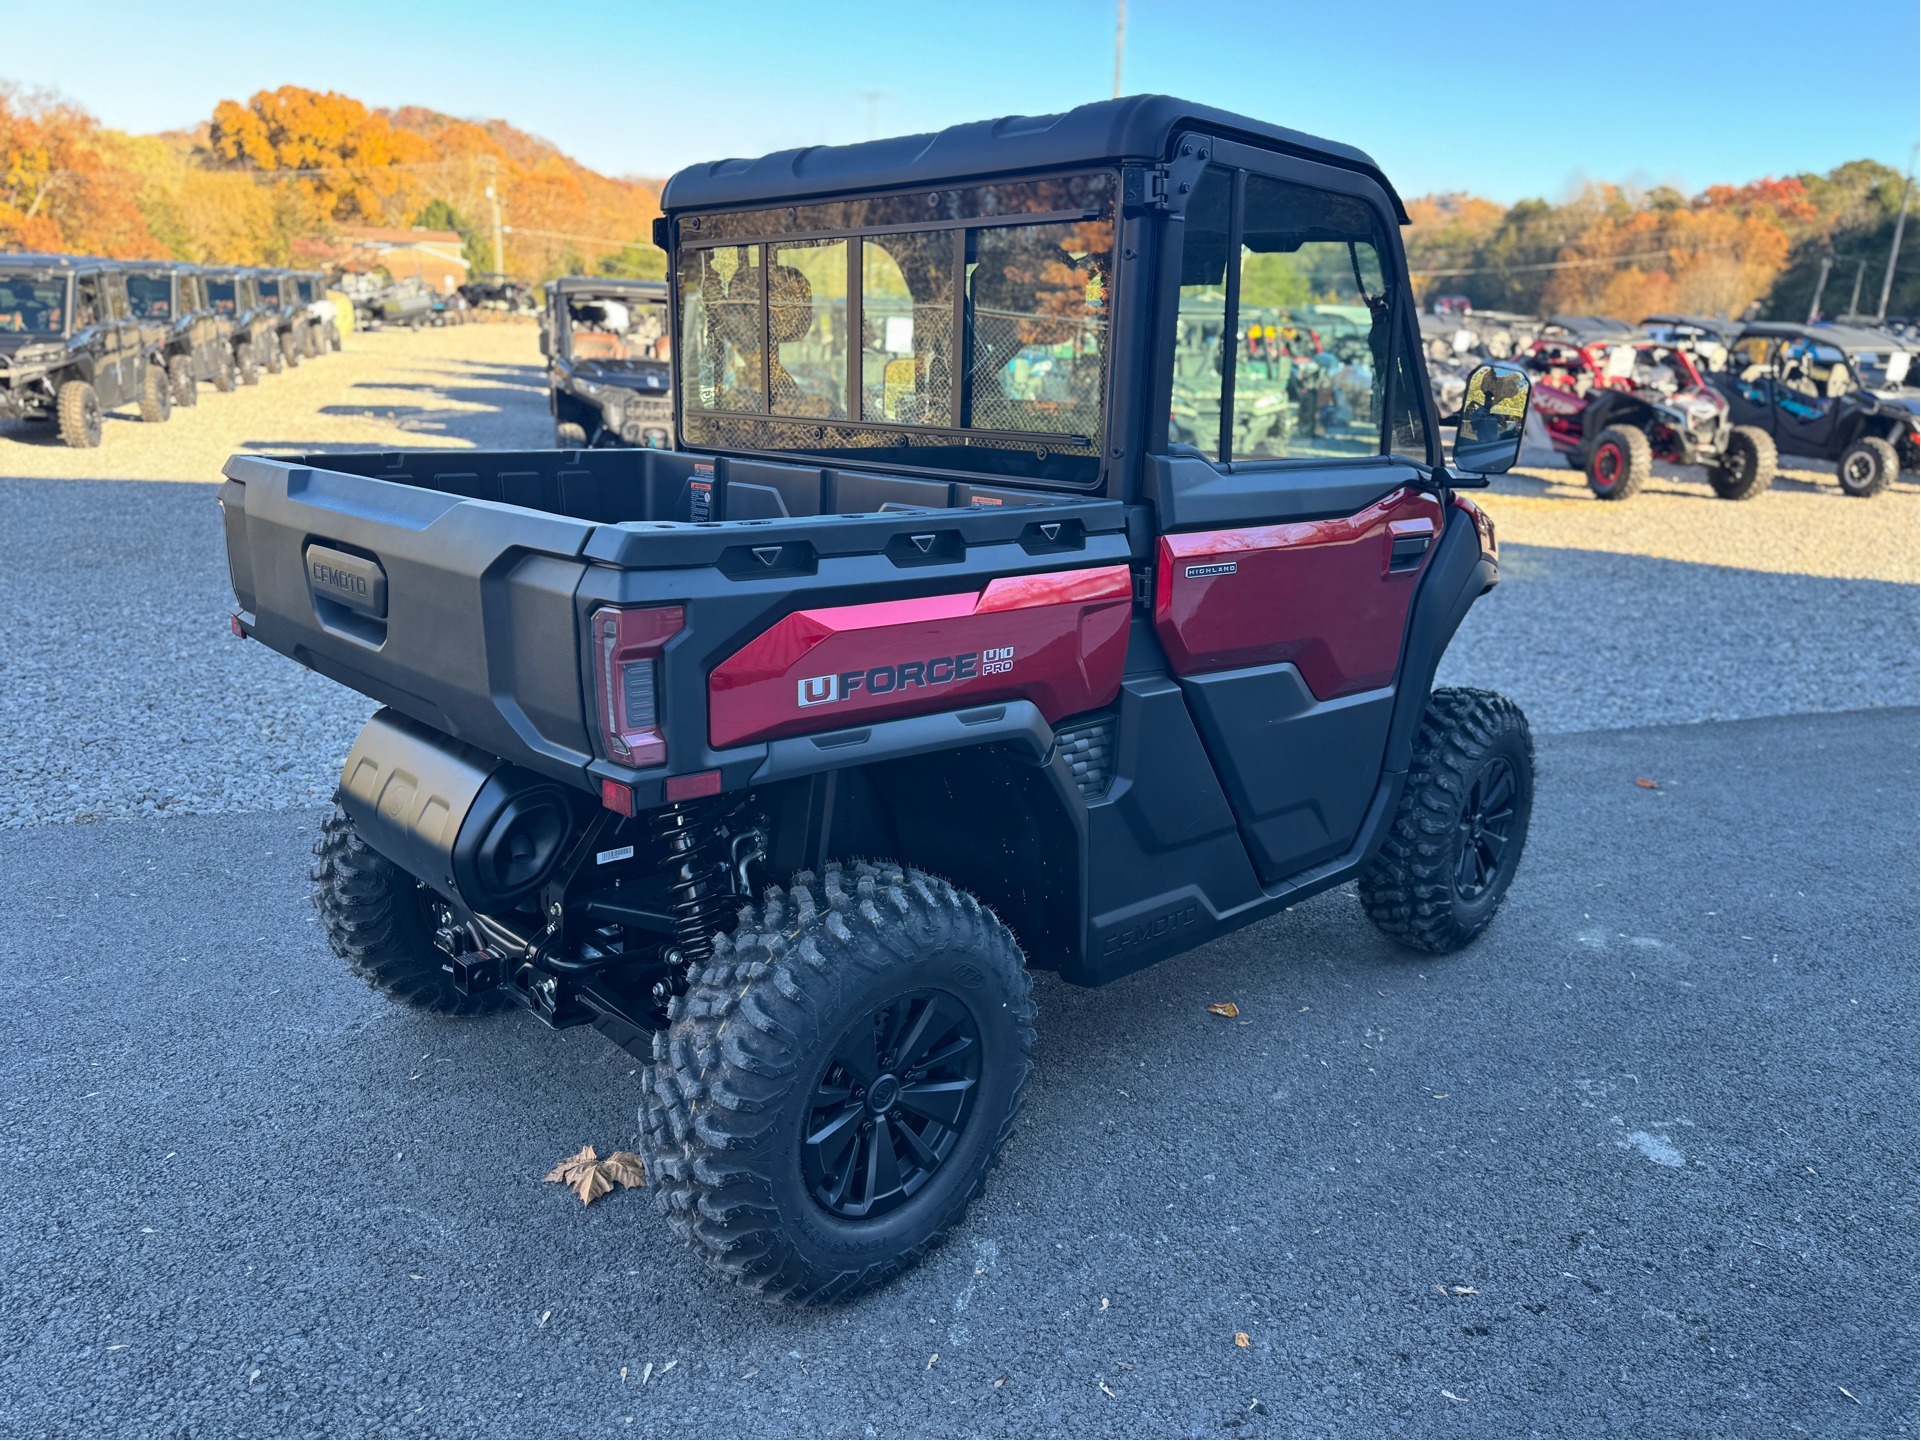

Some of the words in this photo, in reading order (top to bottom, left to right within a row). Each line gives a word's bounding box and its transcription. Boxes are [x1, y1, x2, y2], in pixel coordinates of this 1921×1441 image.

[1188, 565, 1236, 576] HIGHLAND
[313, 562, 368, 598] CFMOTO
[982, 646, 1015, 664] U10
[982, 660, 1014, 677] PRO
[1103, 904, 1198, 957] CFMOTO
